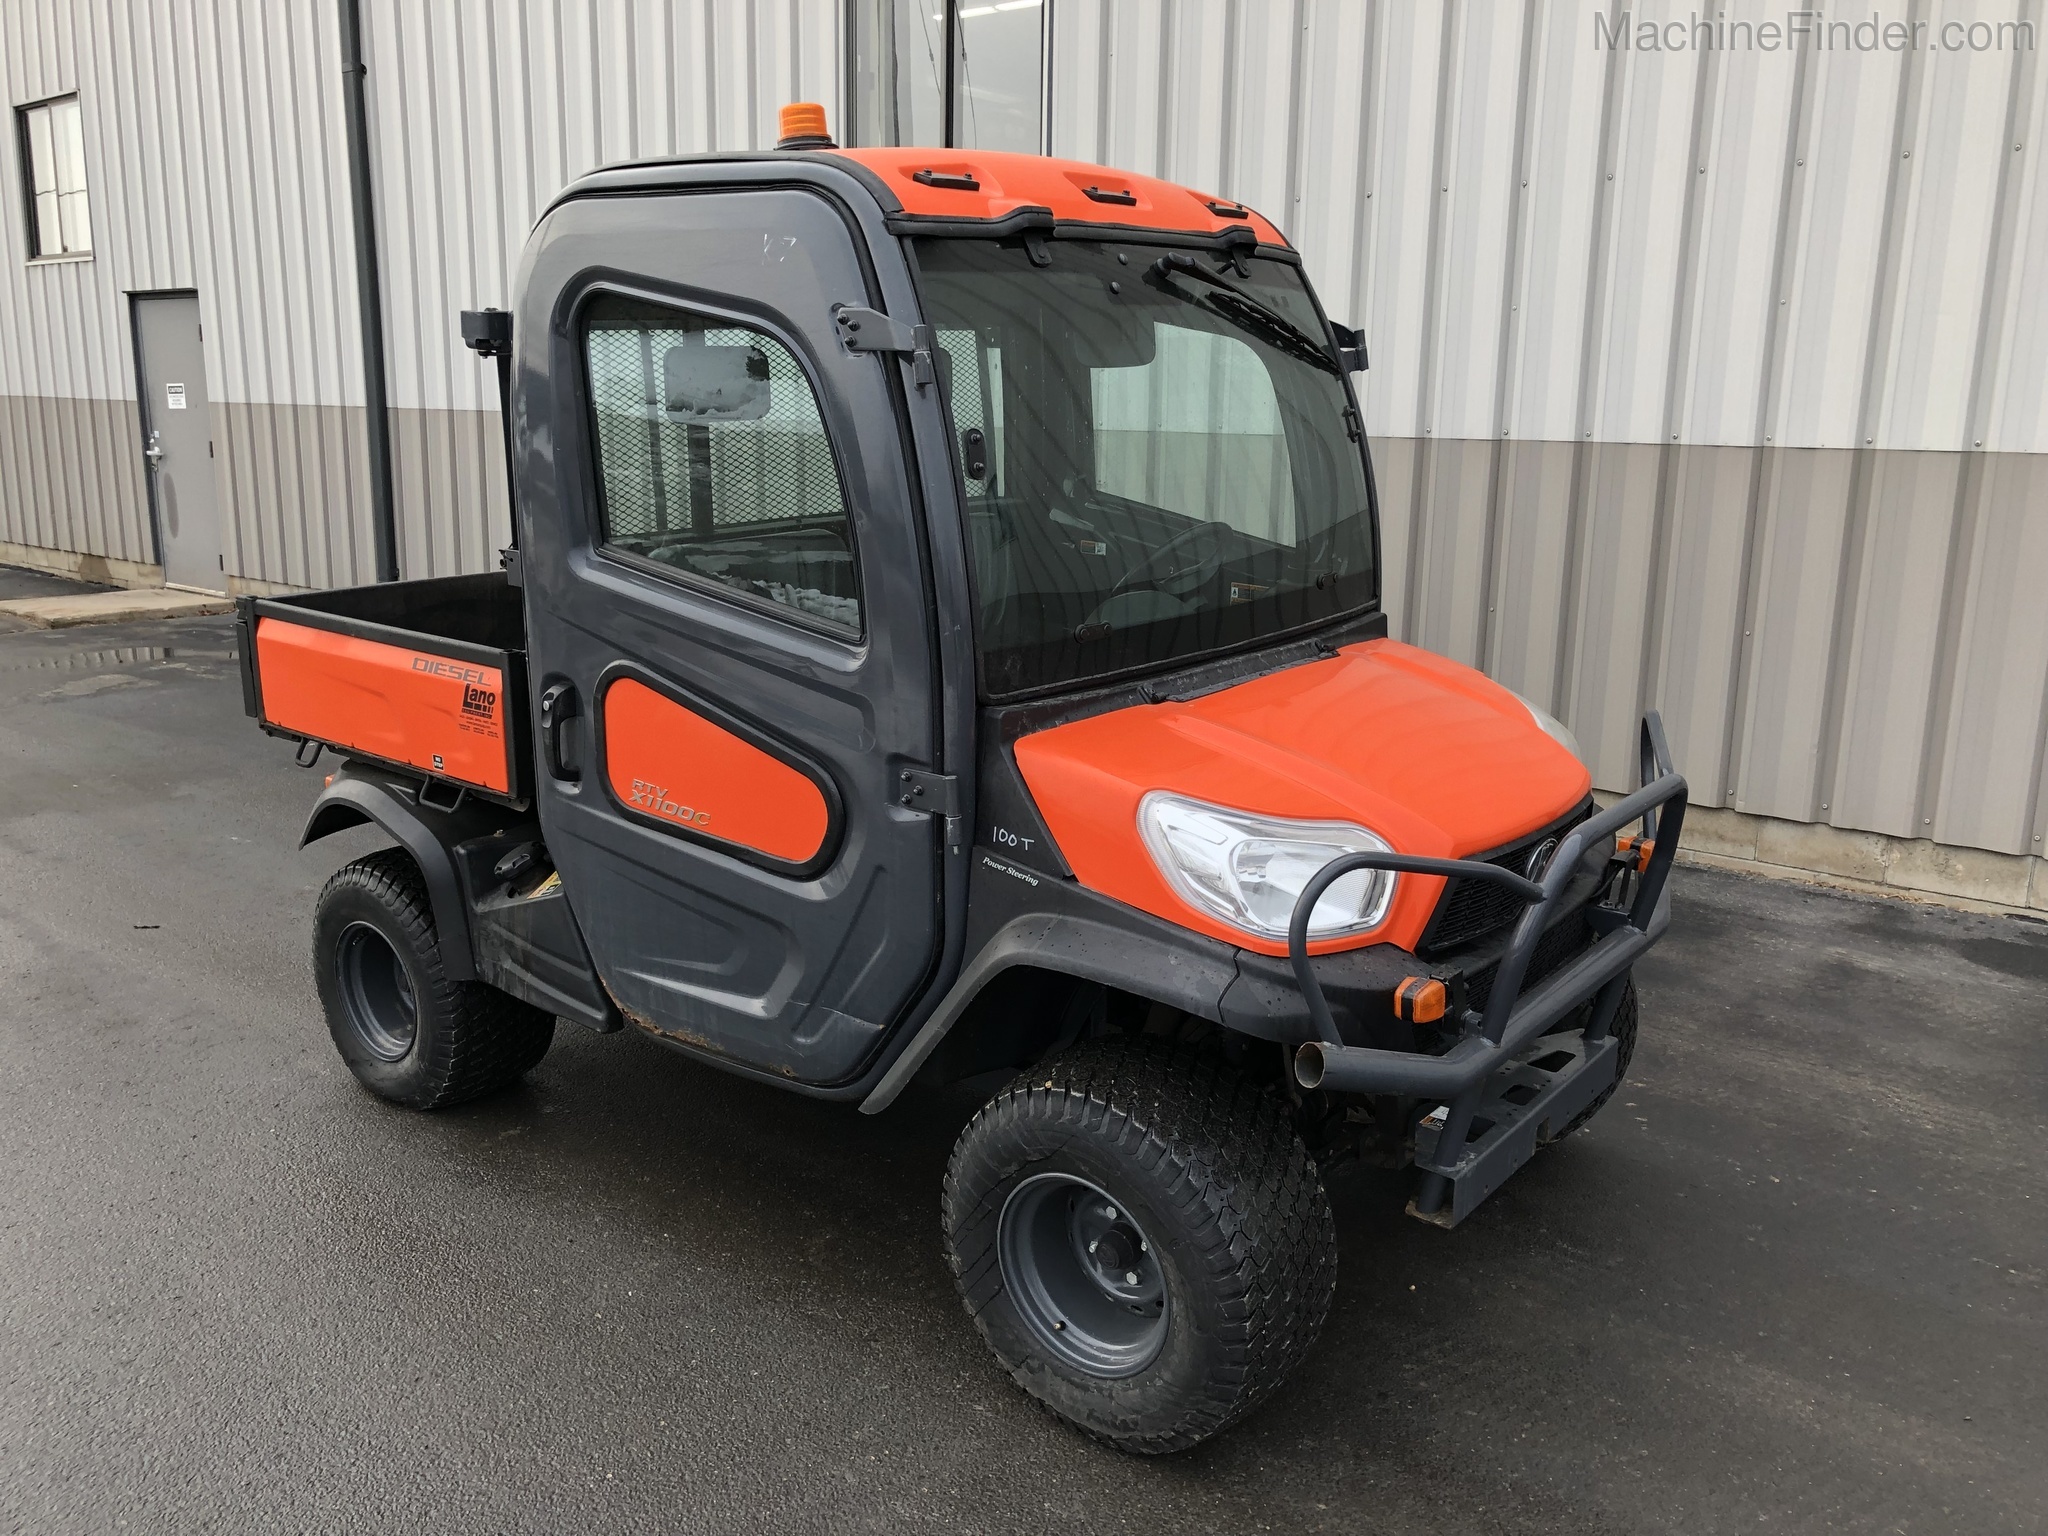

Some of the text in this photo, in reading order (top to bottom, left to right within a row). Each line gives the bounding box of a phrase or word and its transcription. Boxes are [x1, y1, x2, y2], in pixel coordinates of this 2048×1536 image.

[412, 657, 491, 686] DIESEL
[463, 683, 496, 709] Lano
[632, 779, 668, 798] RTV
[629, 789, 711, 826] X1100C
[982, 857, 1039, 886] Power Steering
